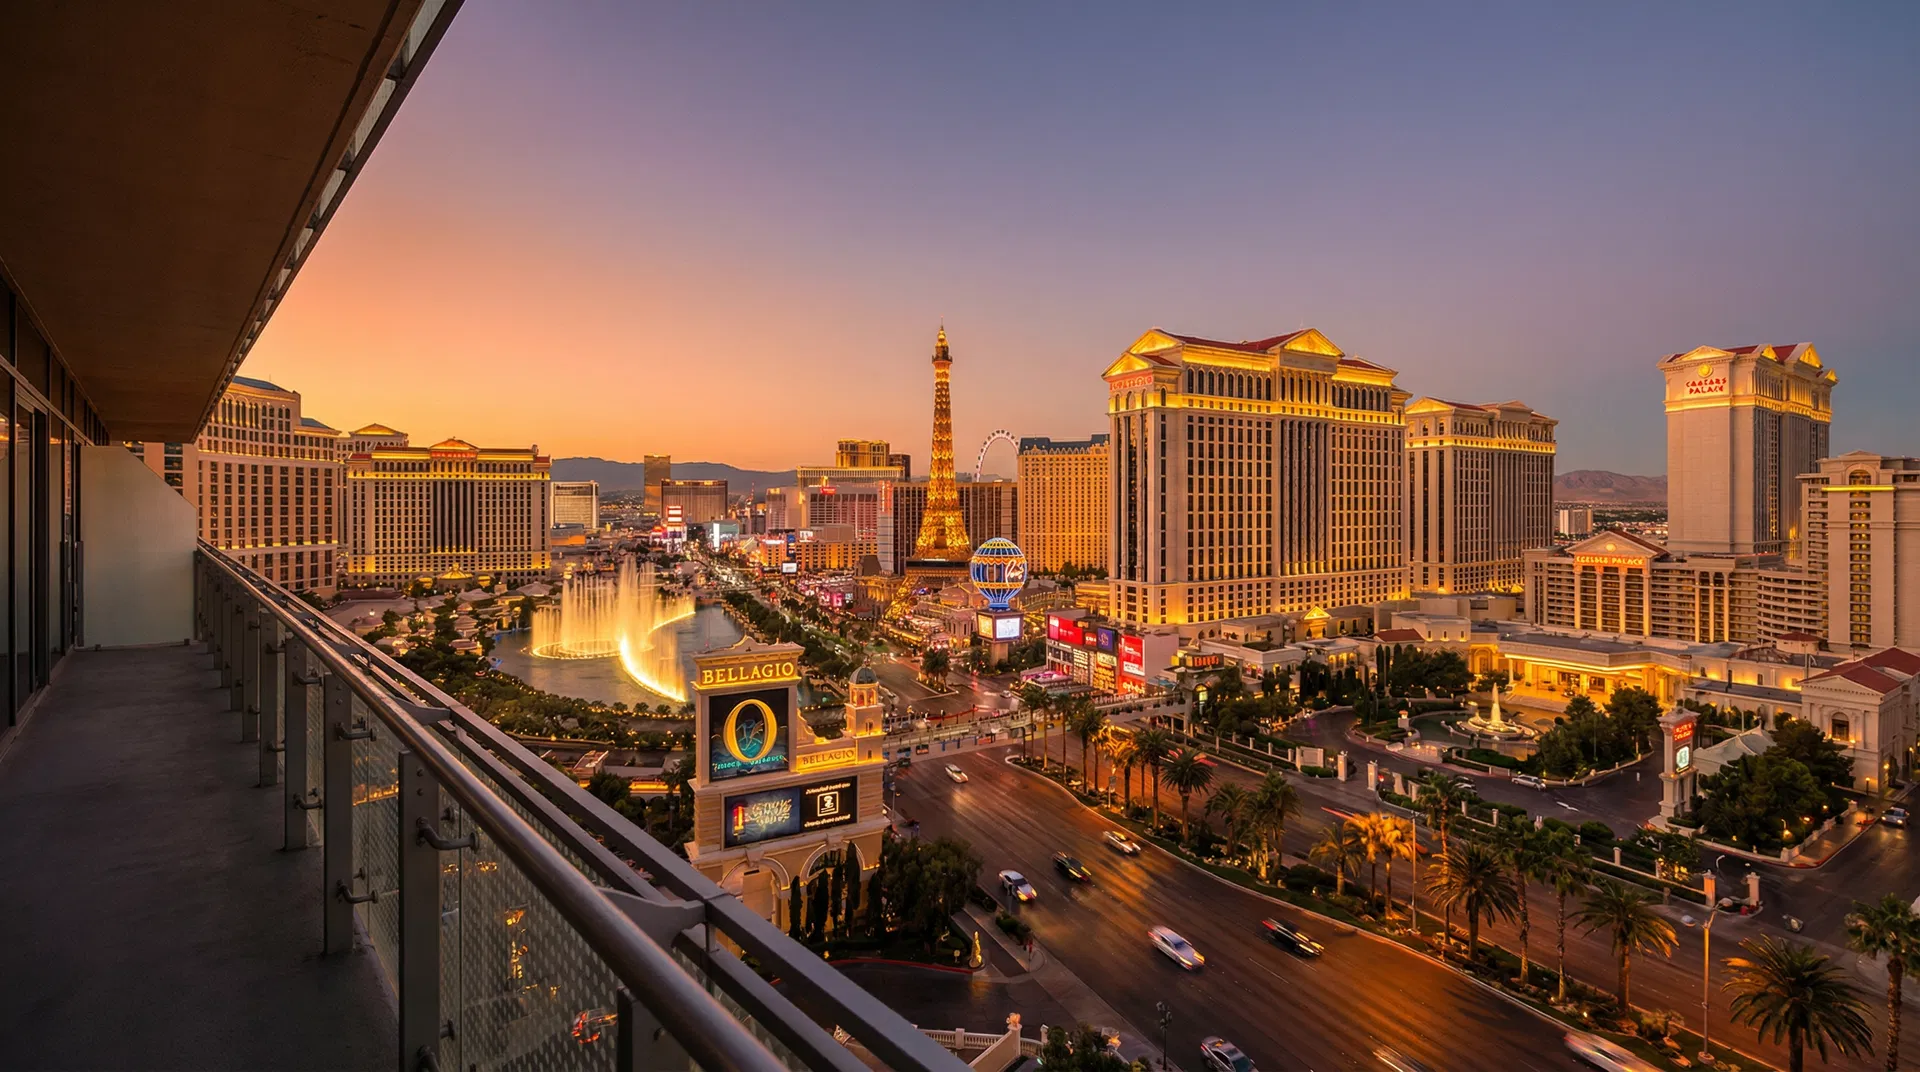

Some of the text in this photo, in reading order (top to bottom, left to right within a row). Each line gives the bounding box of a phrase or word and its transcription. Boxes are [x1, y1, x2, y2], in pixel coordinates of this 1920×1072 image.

[702, 661, 794, 685] BELLAGIO
[723, 699, 777, 761] O
[803, 750, 854, 765] BELLAGIO
